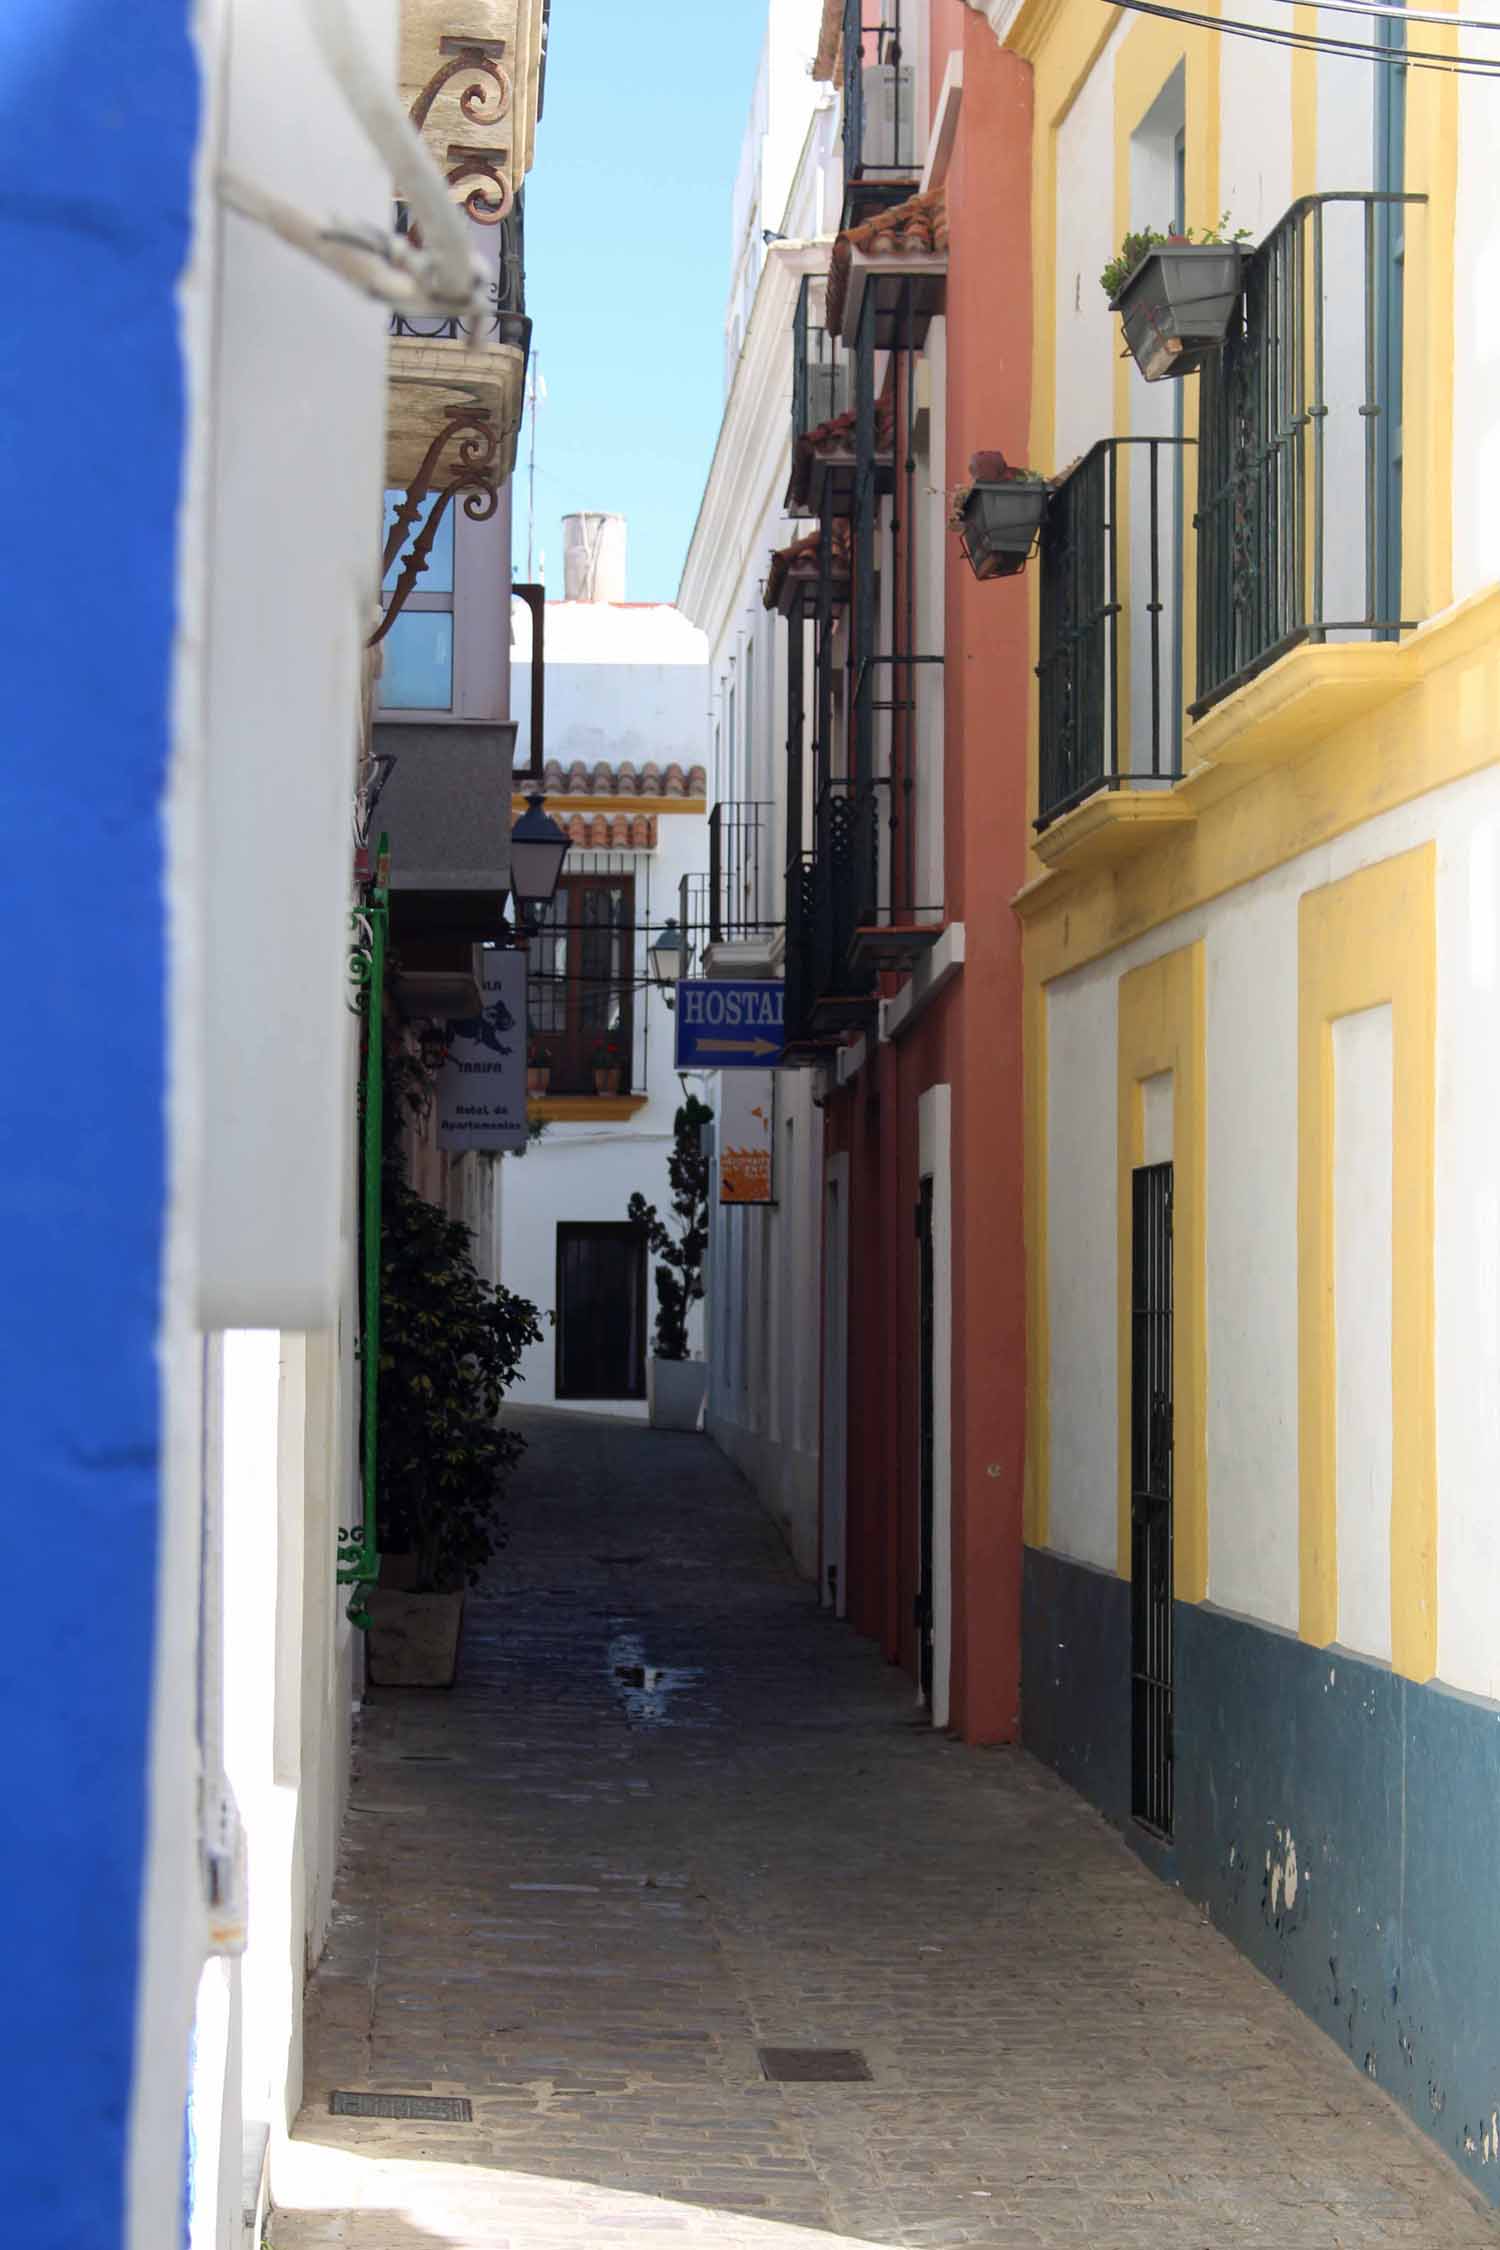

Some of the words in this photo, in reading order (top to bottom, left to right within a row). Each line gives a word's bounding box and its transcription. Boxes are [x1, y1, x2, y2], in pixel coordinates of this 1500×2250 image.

[456, 1103, 489, 1115] Hotel
[493, 1103, 508, 1115] de
[441, 1120, 521, 1132] Apartamentos
